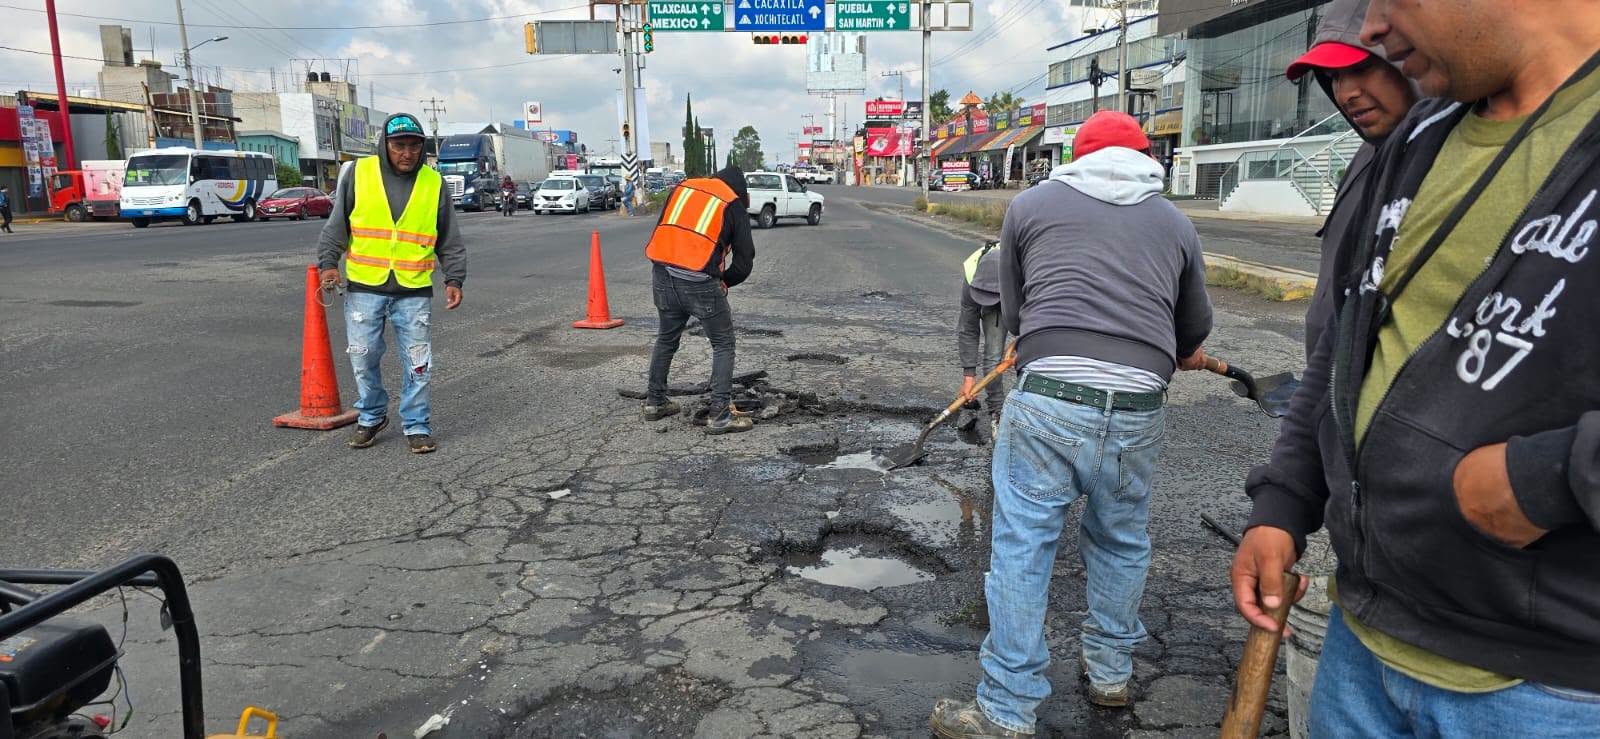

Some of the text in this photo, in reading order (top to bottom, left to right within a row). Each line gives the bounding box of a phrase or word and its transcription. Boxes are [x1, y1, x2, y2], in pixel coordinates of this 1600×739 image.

[651, 4, 698, 14] TLAXCALA
[754, 0, 804, 9] CACAXTLA
[838, 3, 873, 14] PUEBLA
[652, 18, 698, 28] MEXICO
[754, 14, 805, 25] XOCHITECATL
[838, 17, 884, 28] SAN MARTIN
